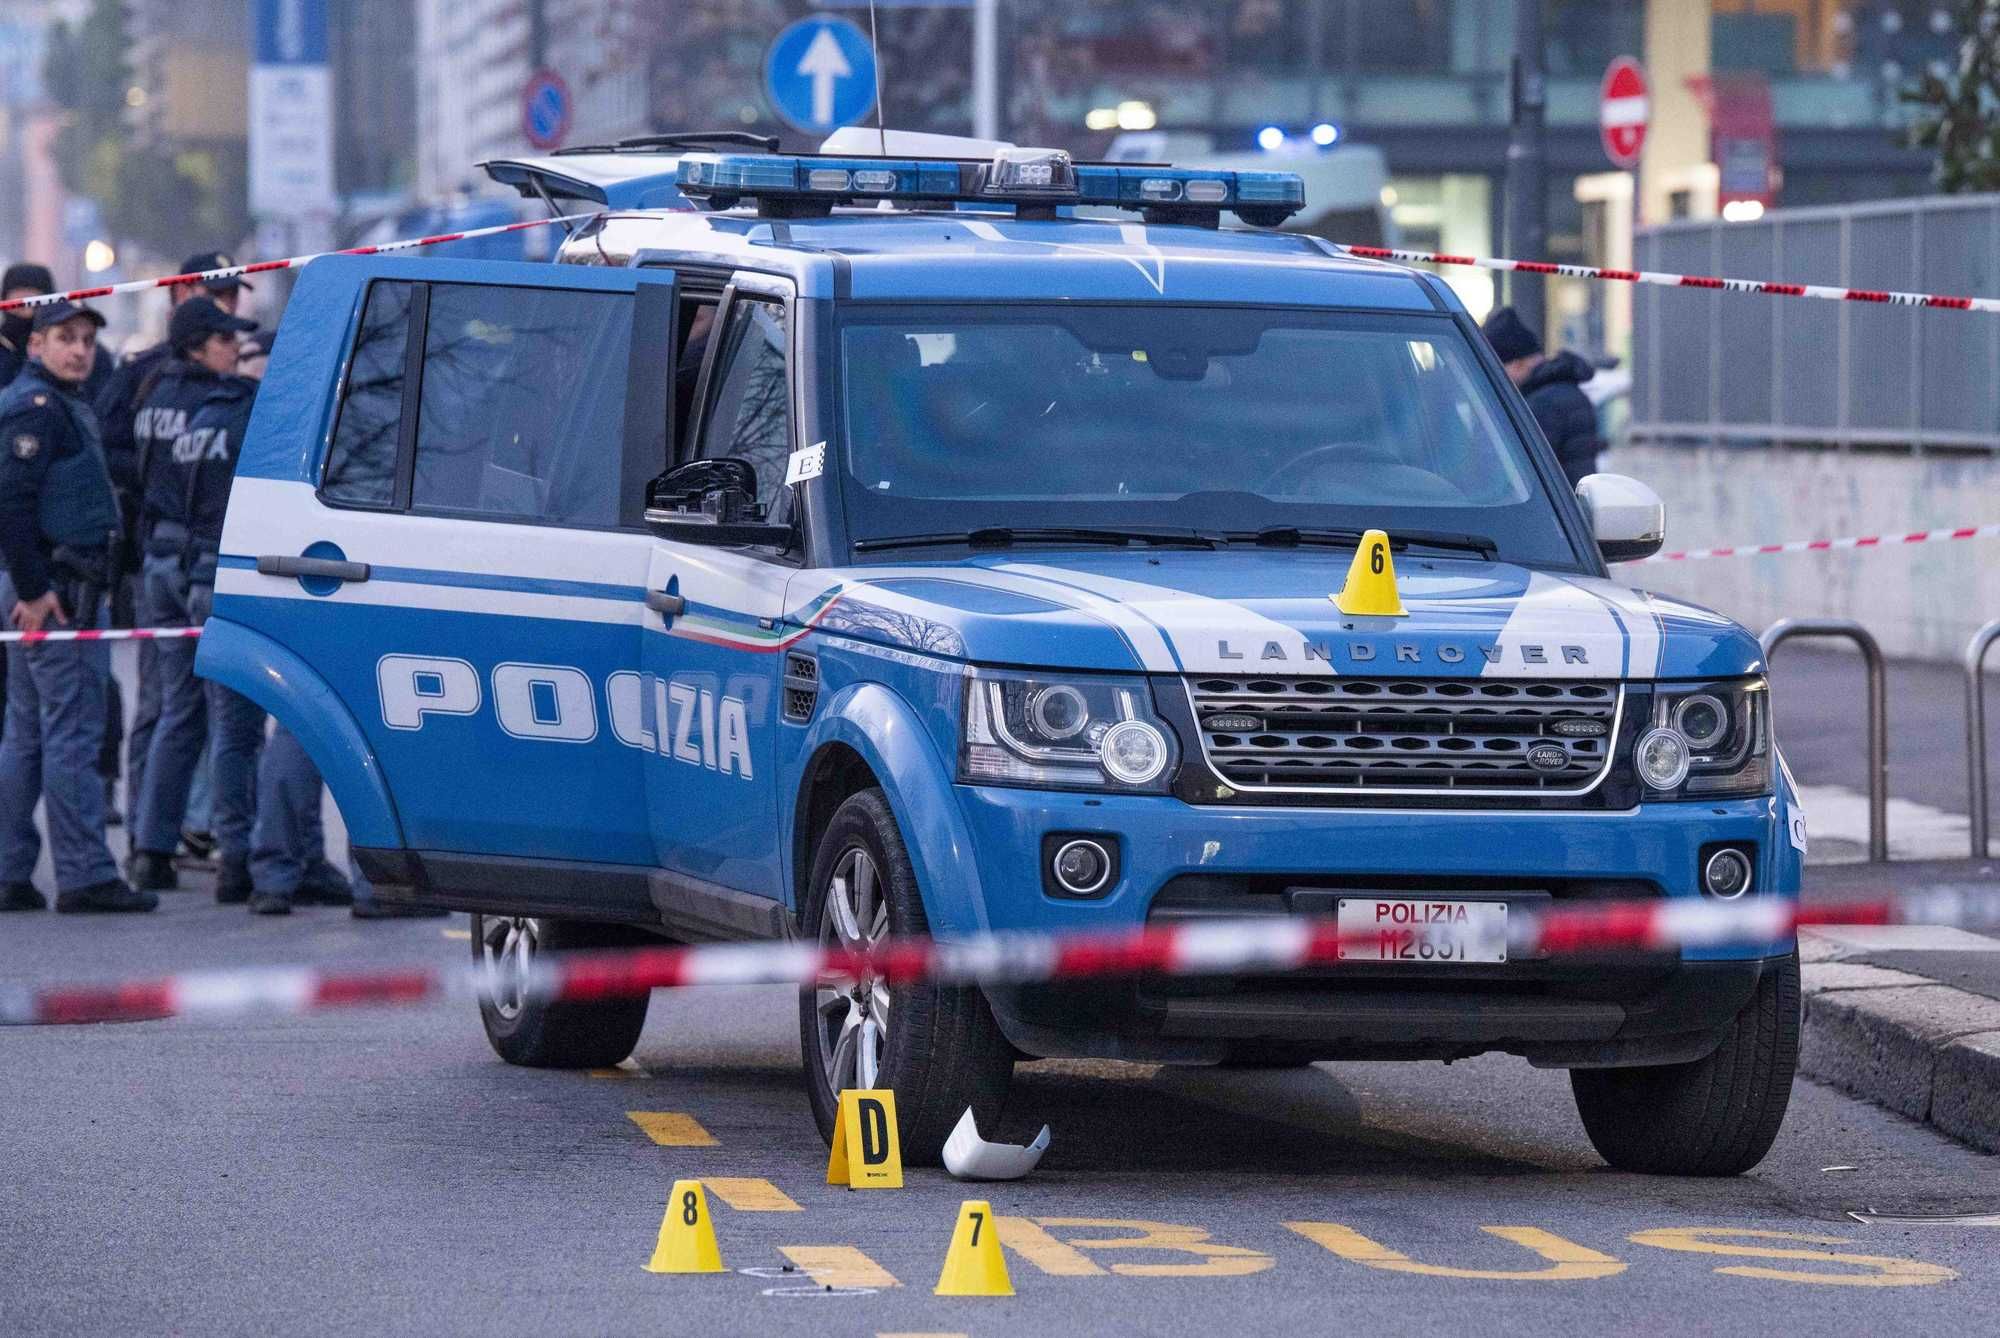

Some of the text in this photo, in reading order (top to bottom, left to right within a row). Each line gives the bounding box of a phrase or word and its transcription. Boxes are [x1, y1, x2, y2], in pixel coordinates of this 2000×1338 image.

[799, 456, 814, 475] E
[1371, 542, 1384, 575] 6
[376, 653, 753, 781] POLIZIA
[1375, 903, 1469, 925] POLIZIA
[858, 1098, 889, 1165] D
[683, 1190, 697, 1226] 8
[968, 1212, 985, 1248] 7
[994, 1215, 1960, 1287] BUS
